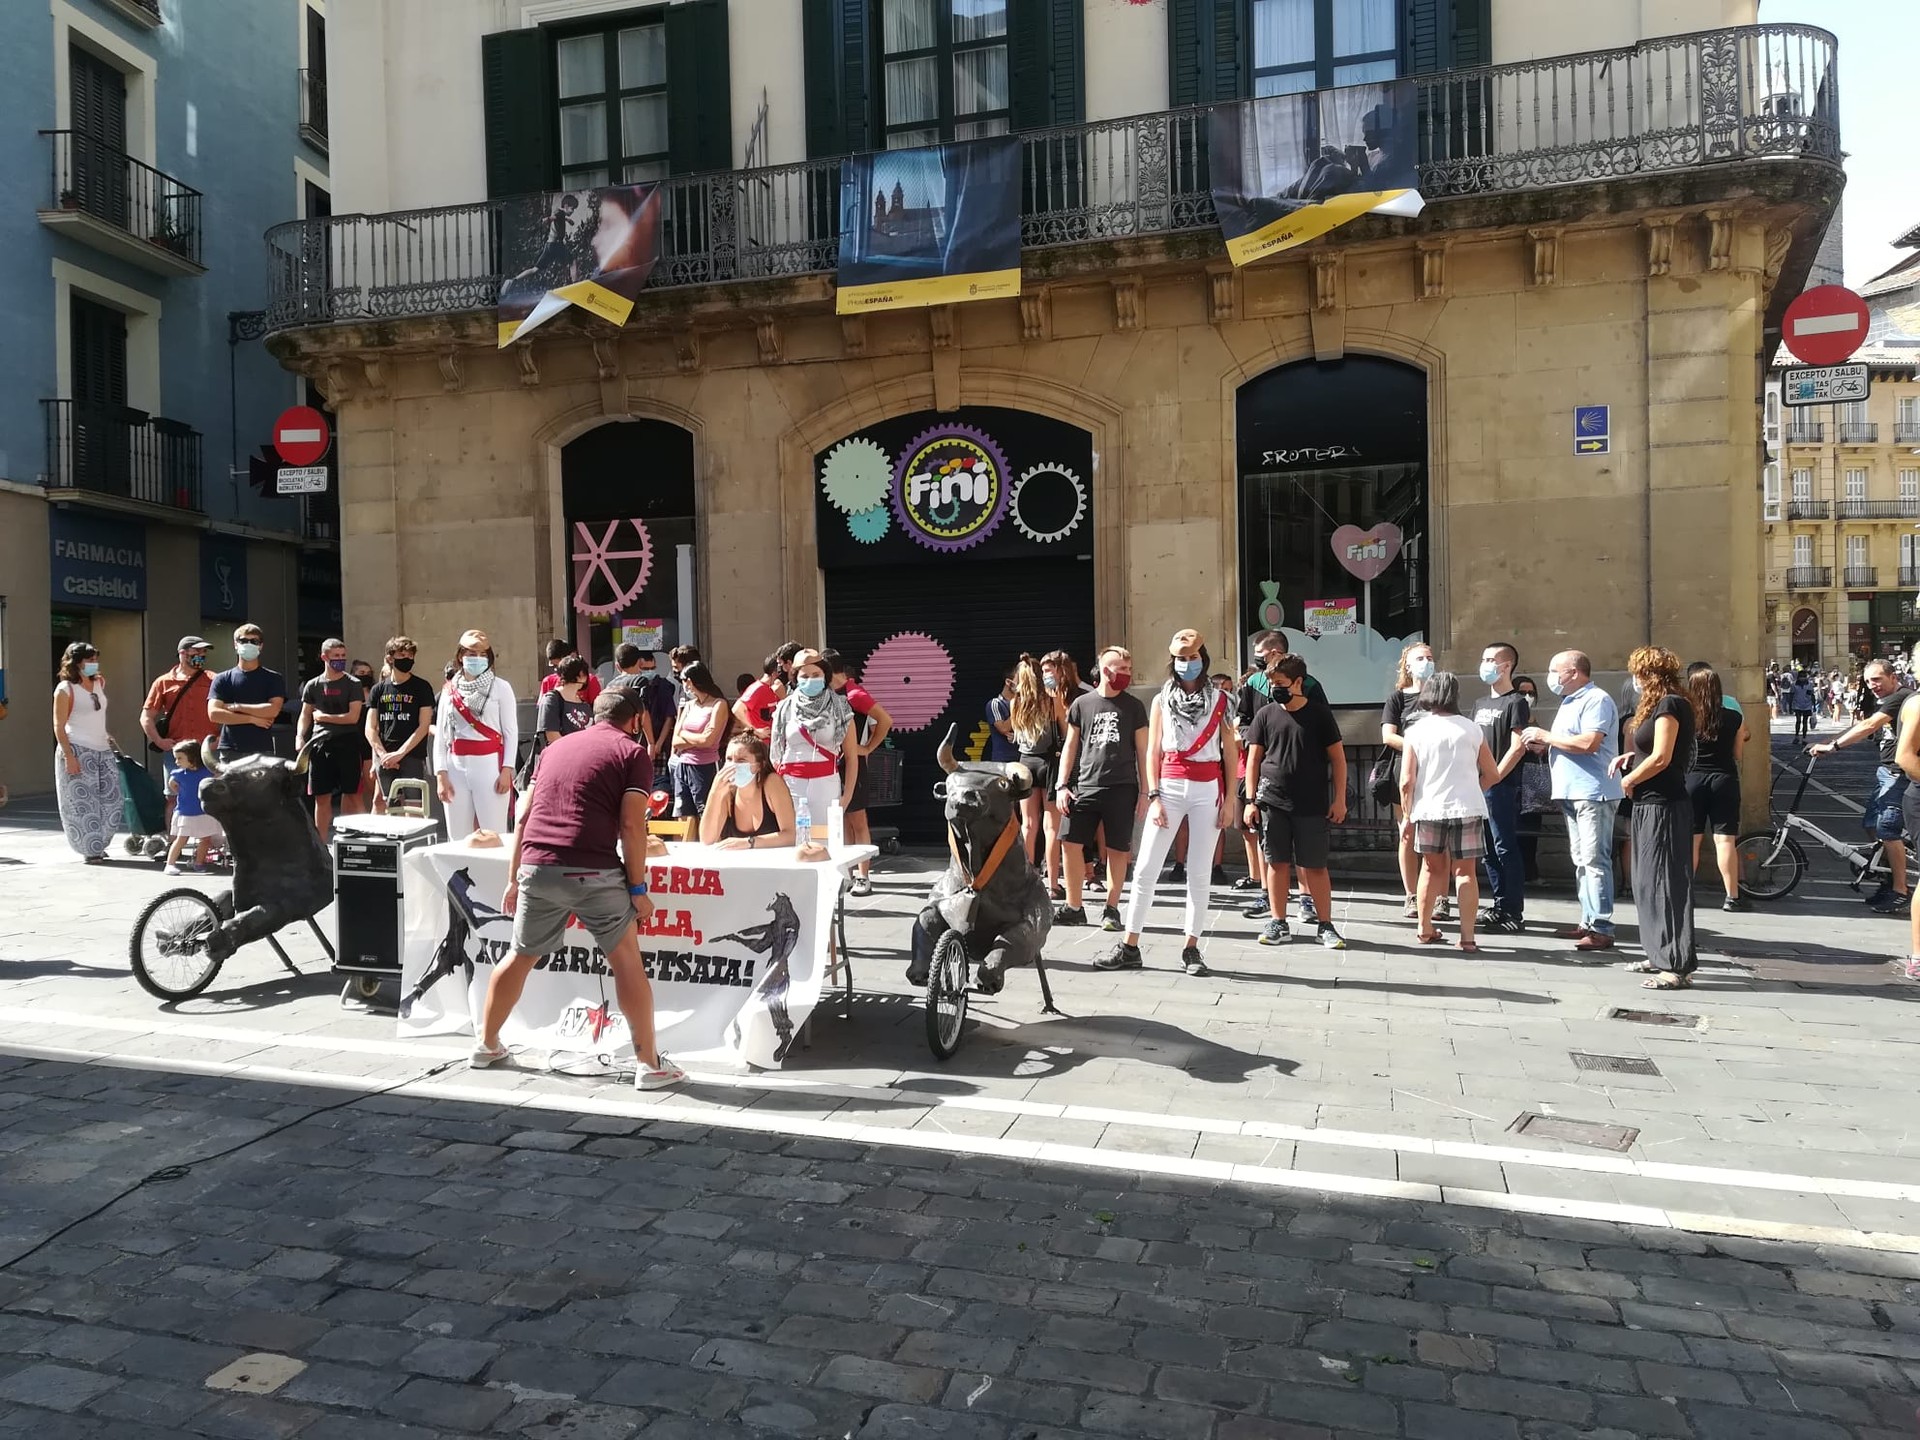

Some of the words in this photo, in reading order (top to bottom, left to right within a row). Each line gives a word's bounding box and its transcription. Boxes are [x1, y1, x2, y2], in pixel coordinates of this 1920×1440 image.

[1790, 370, 1827, 380] EXCEPTO
[910, 461, 989, 509] Fini
[54, 538, 144, 569] FARMACIA
